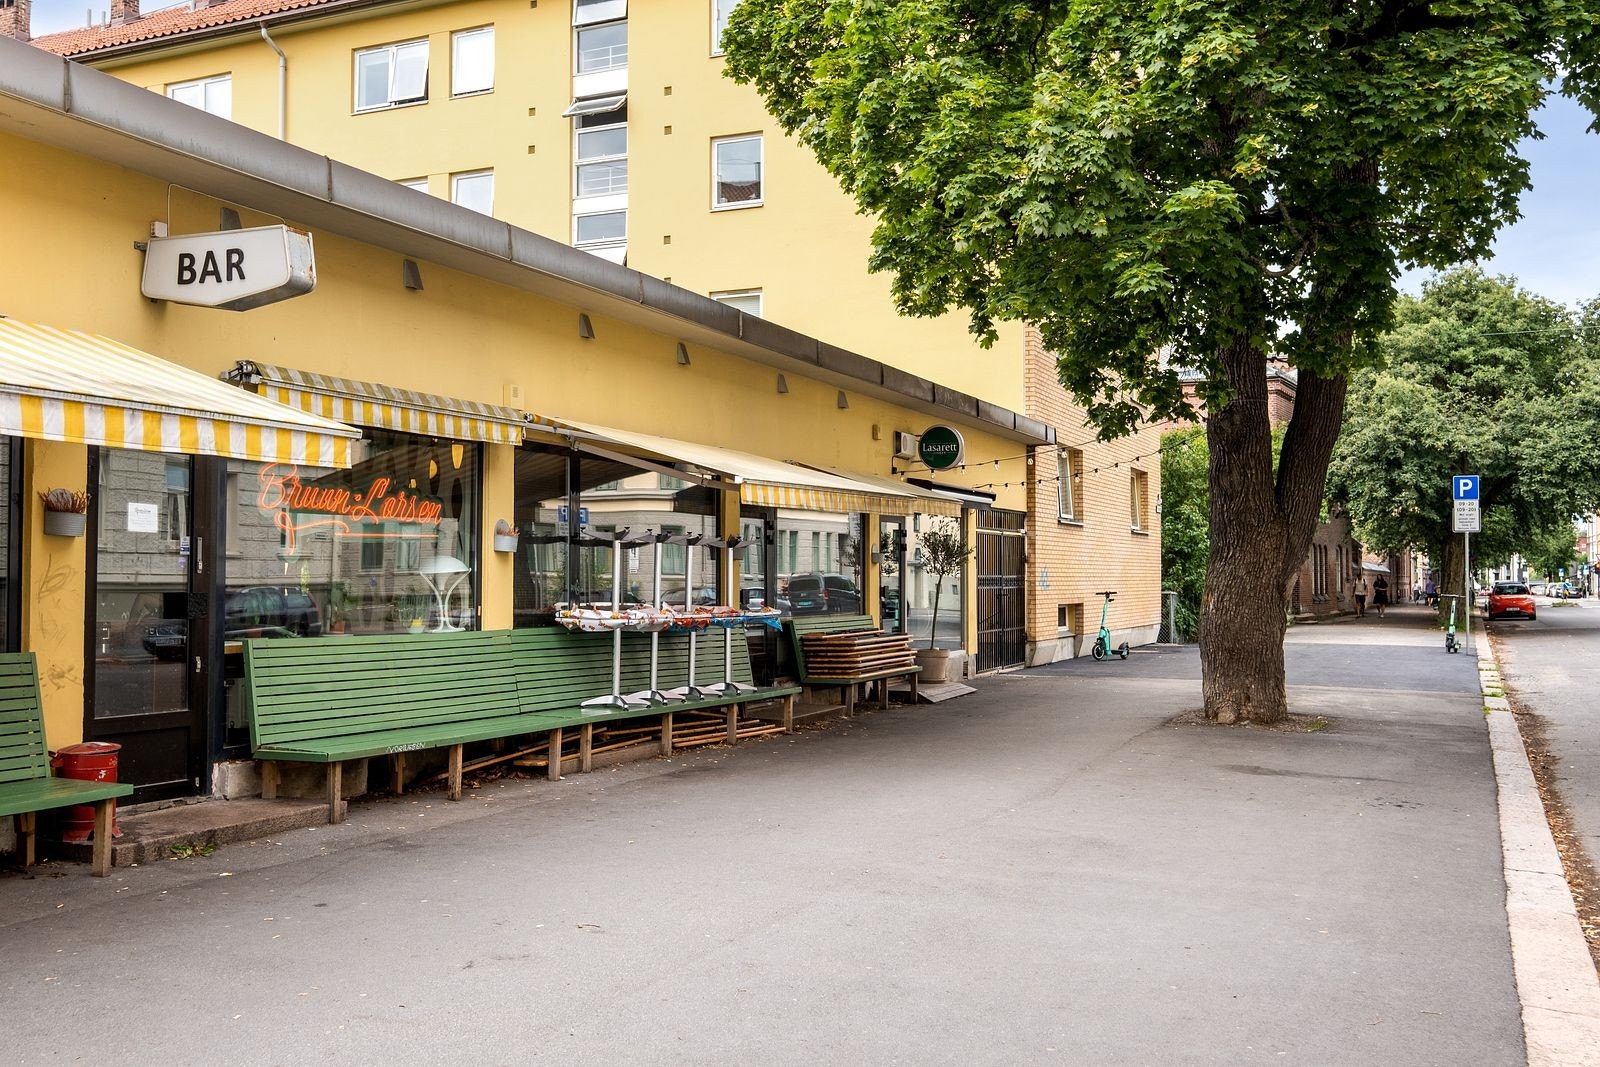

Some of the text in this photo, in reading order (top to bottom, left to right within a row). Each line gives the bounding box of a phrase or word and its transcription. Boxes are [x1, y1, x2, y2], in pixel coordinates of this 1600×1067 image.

[177, 248, 246, 285] BAR
[923, 443, 957, 451] Lasarett
[1460, 479, 1473, 497] P
